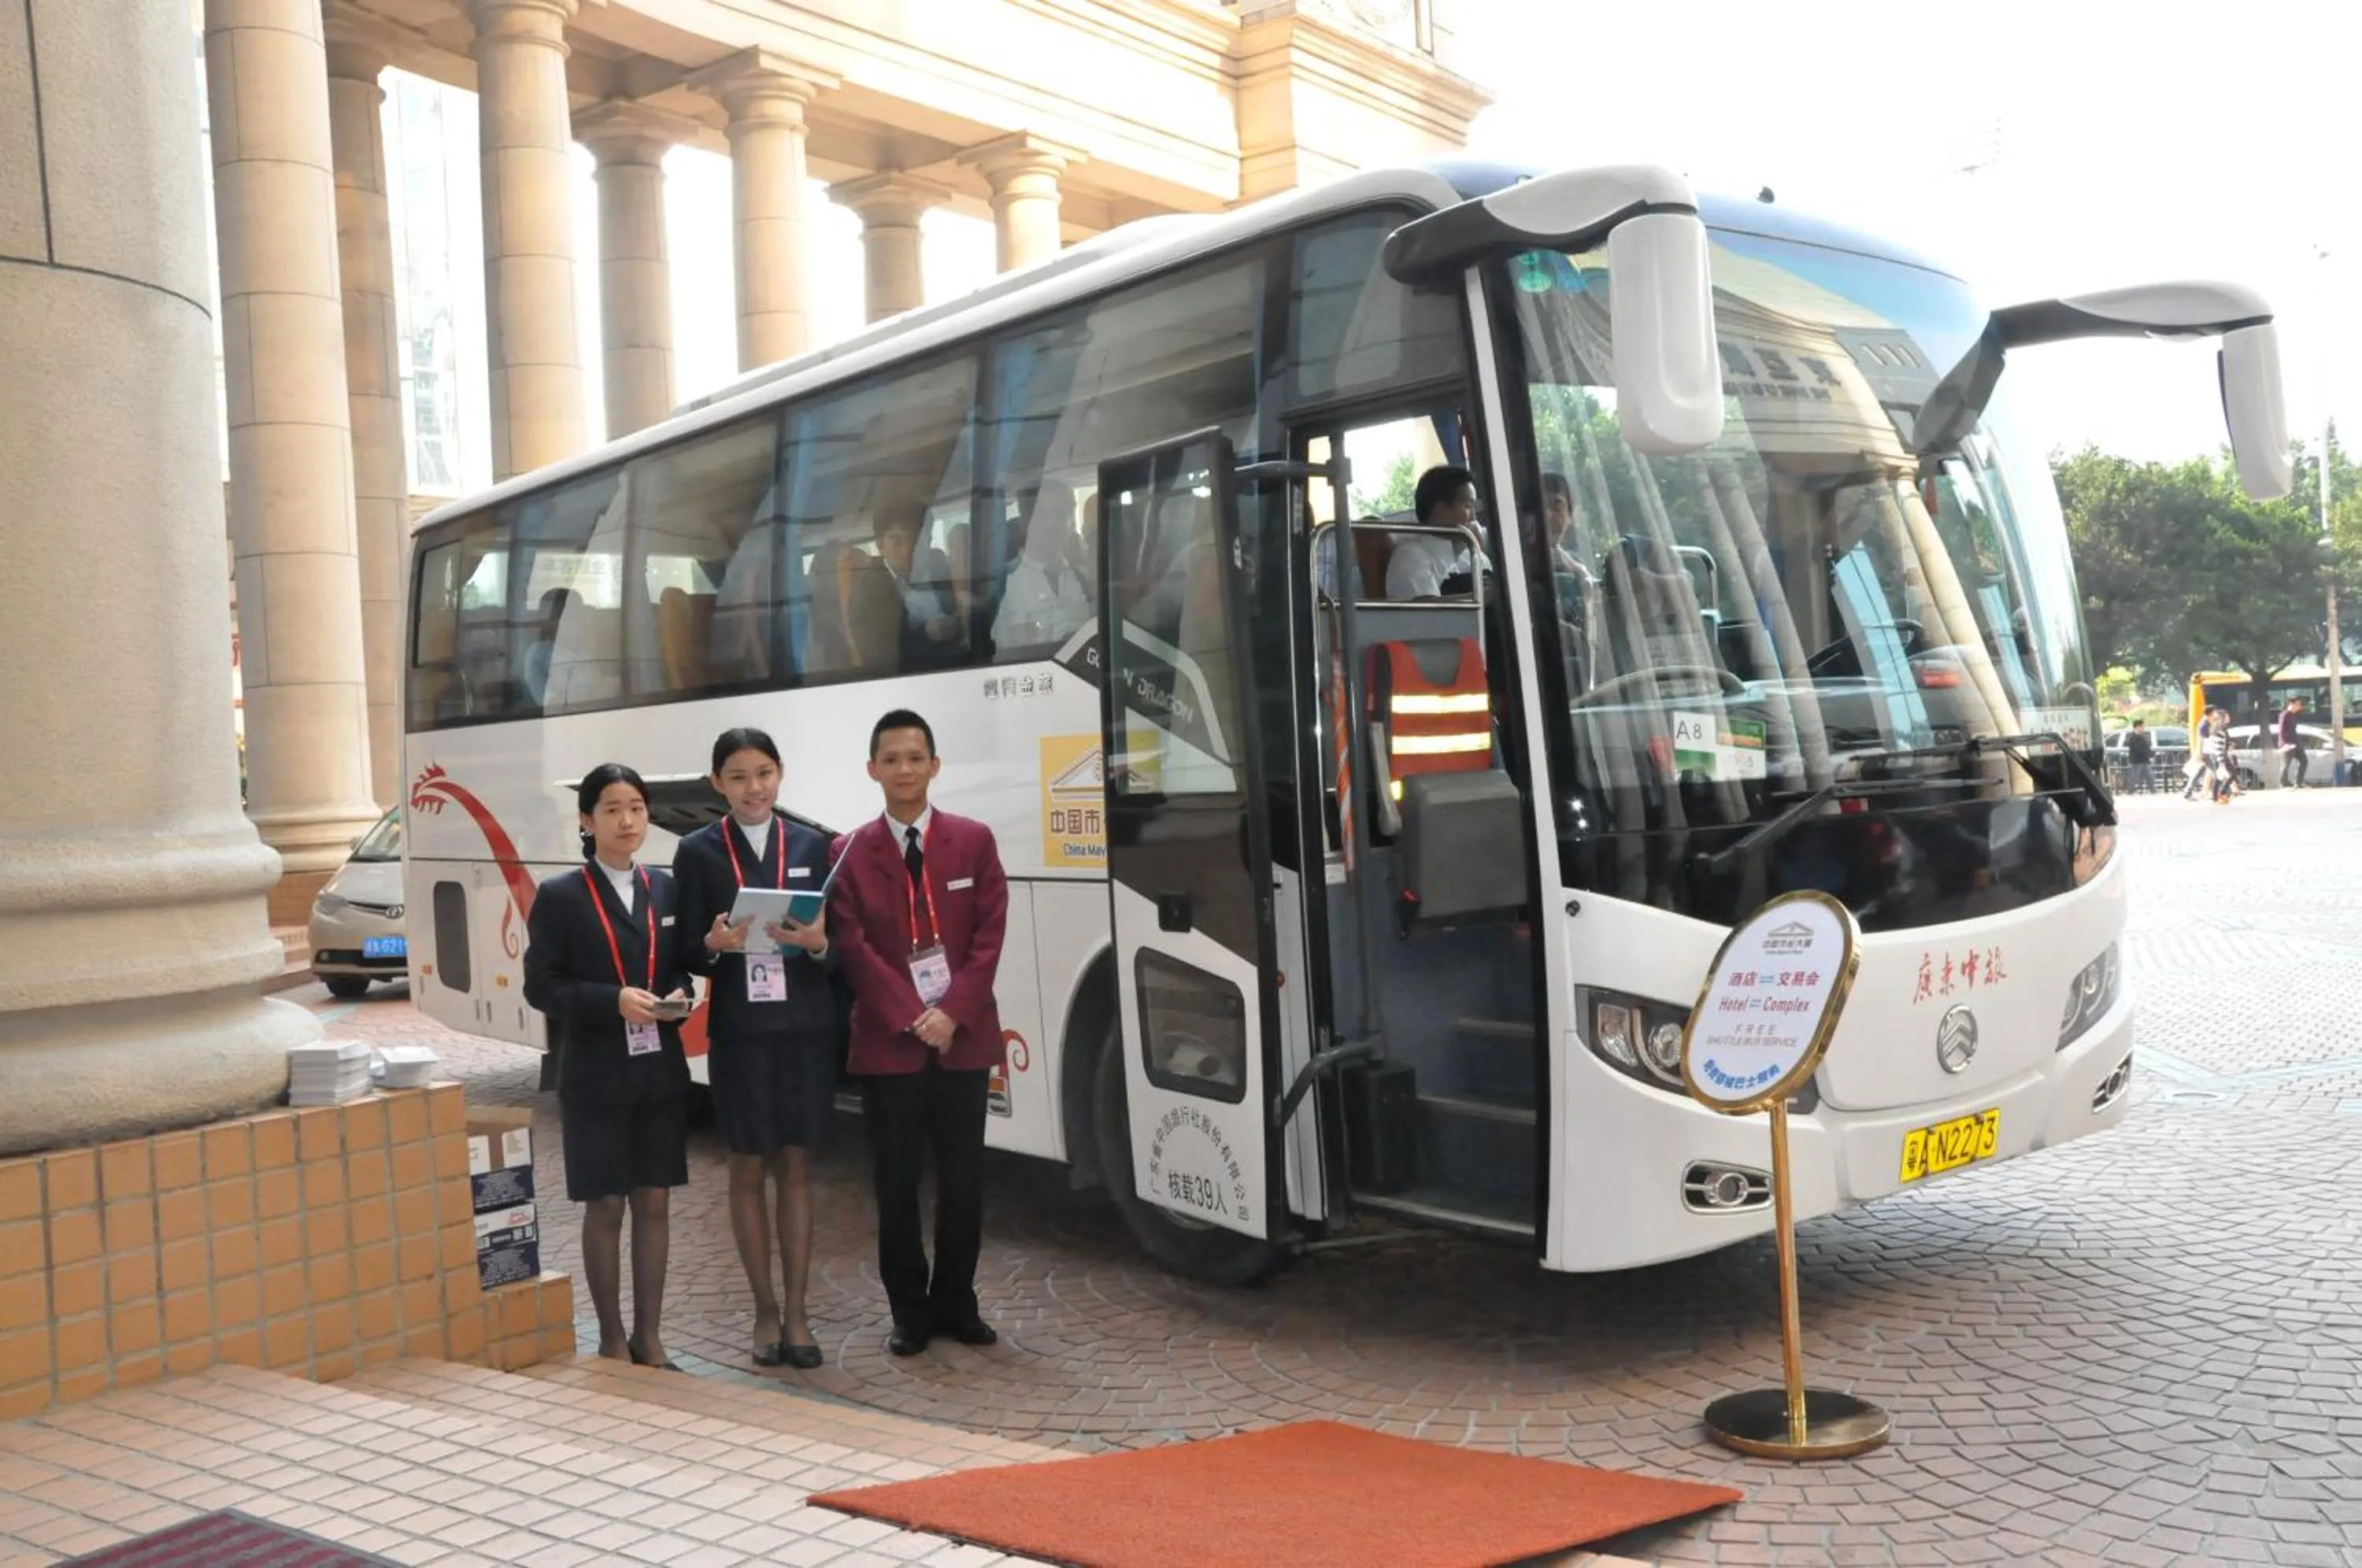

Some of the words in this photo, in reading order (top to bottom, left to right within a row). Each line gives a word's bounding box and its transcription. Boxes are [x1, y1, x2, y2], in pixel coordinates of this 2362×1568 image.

[1051, 808, 1101, 834] 中国市
[1728, 971, 1758, 986] 酒店
[1776, 971, 1820, 986] 交易会
[1719, 996, 1749, 1011] Hotel
[1763, 997, 1811, 1015] Complex
